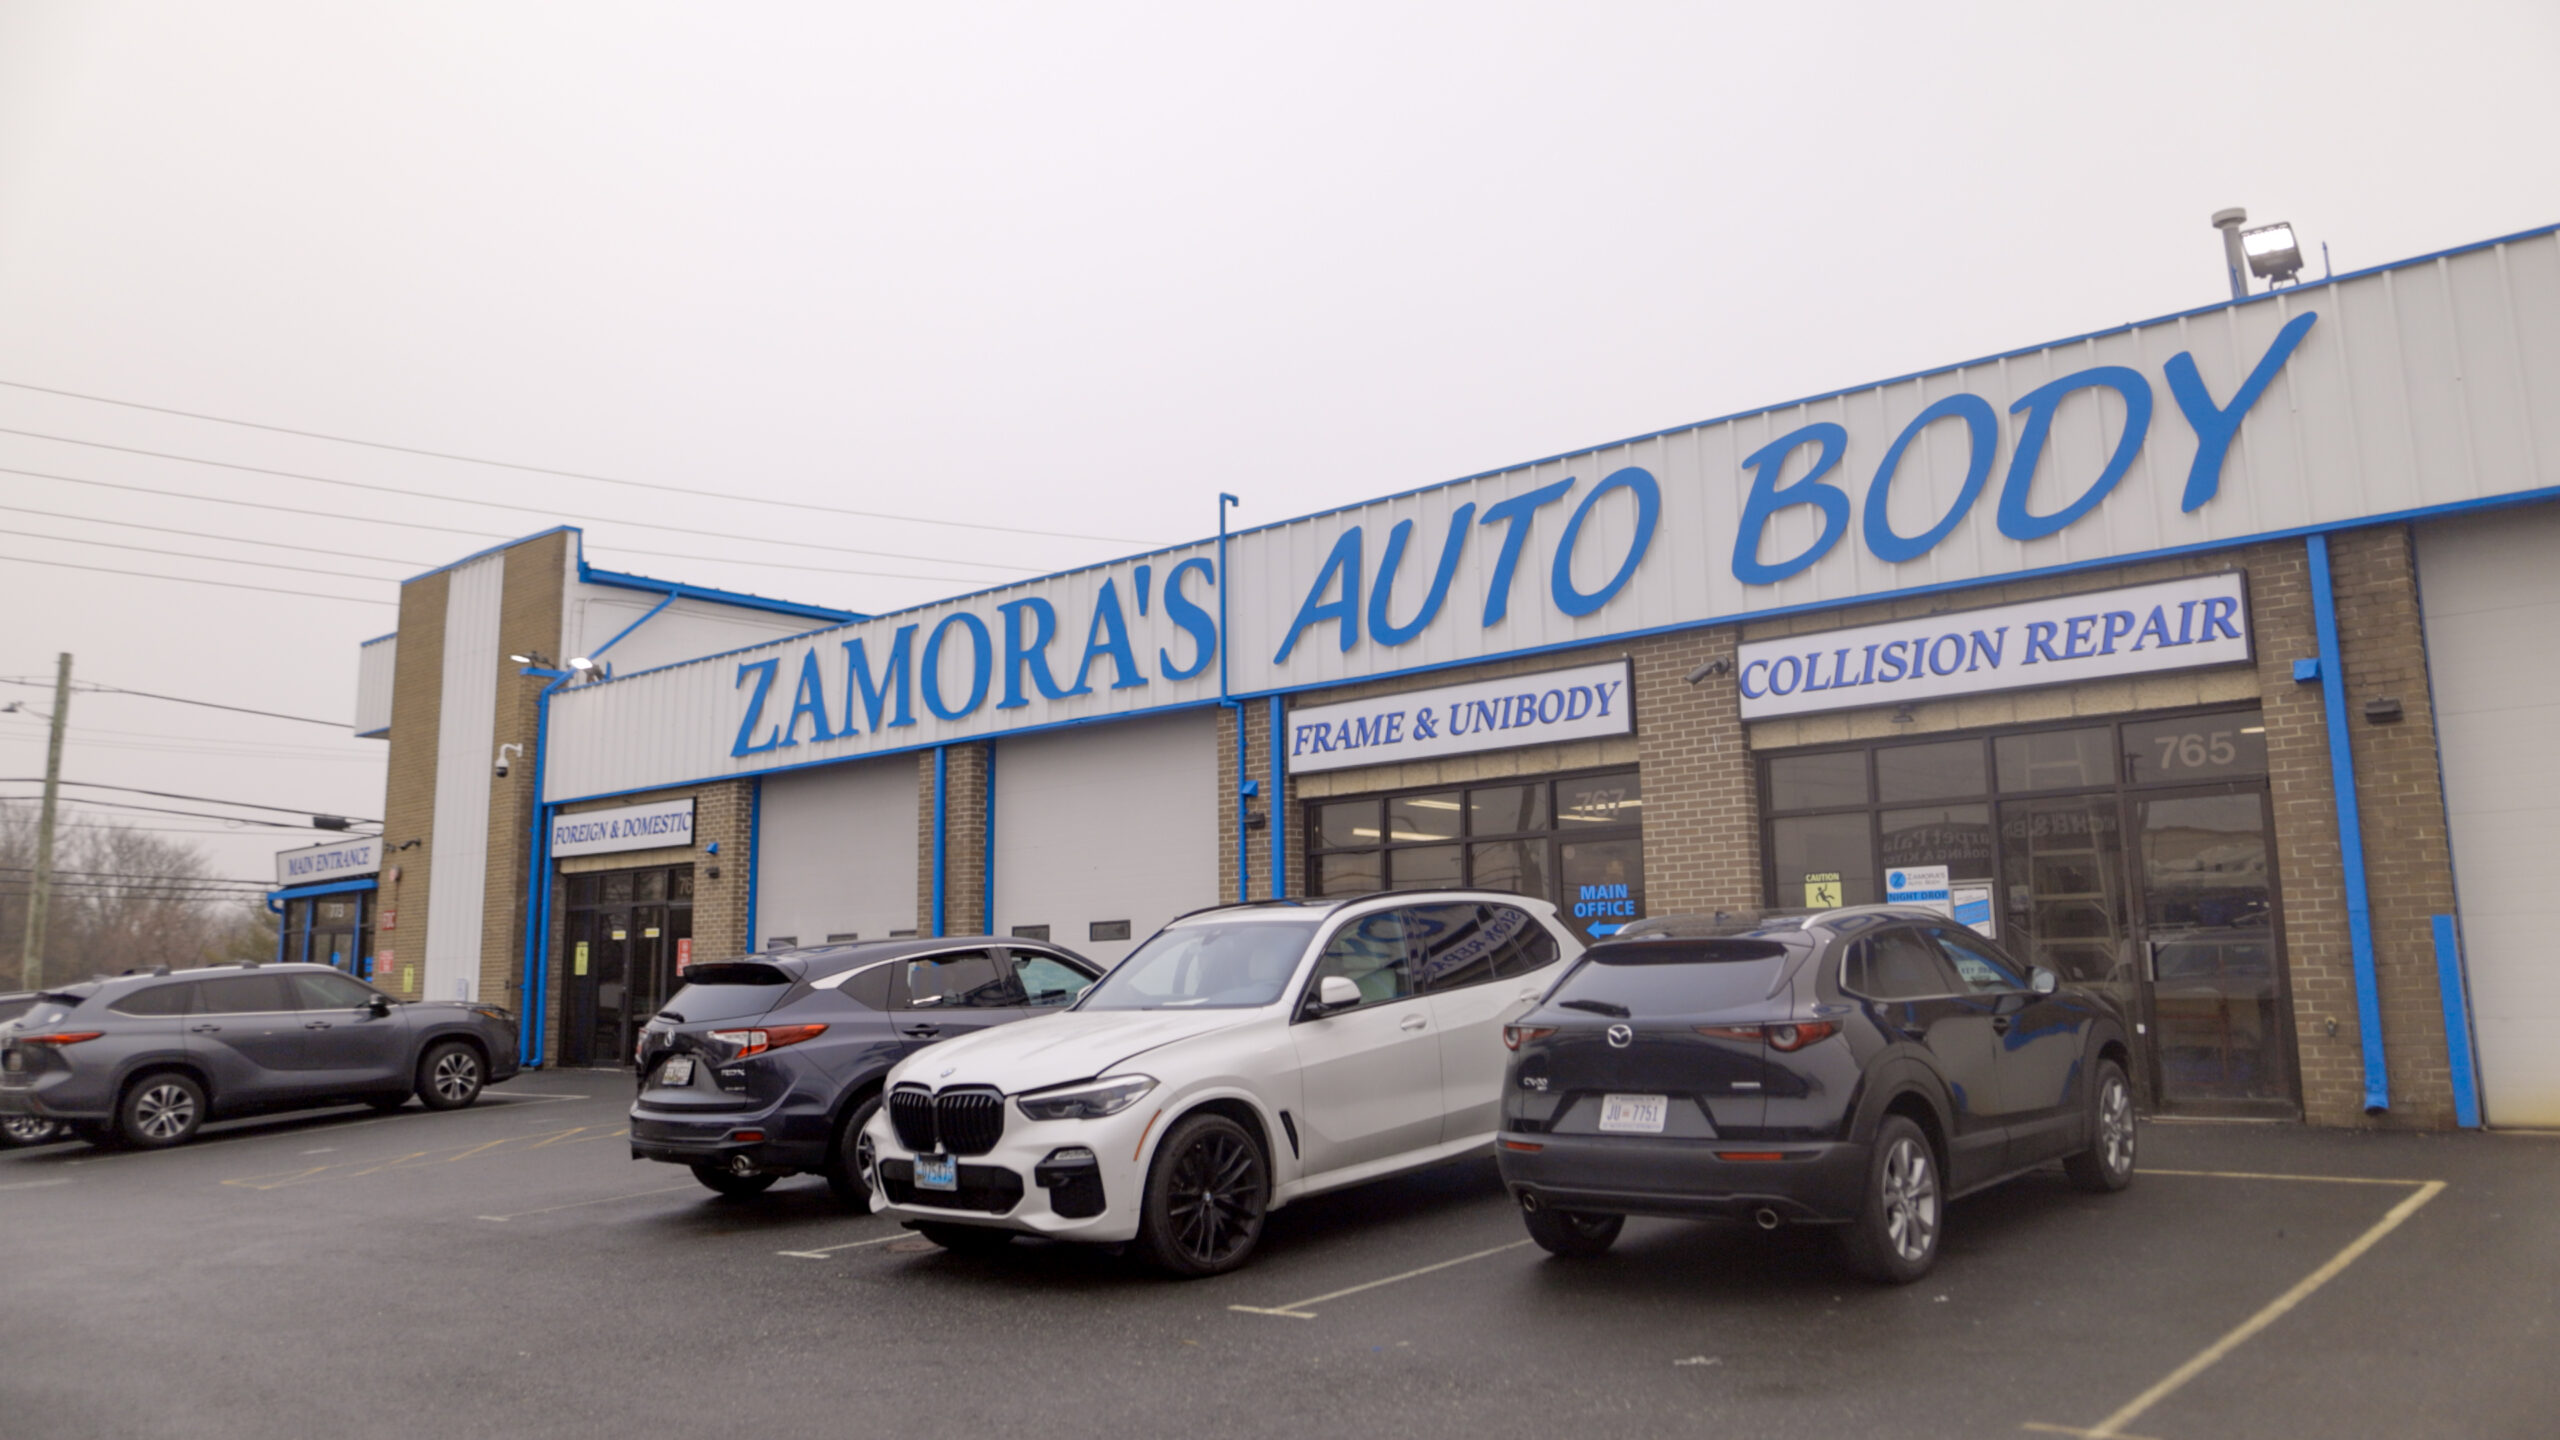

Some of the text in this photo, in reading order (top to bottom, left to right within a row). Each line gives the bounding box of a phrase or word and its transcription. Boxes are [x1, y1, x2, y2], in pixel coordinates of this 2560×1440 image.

[1273, 311, 2318, 665] AUTO BODY
[730, 557, 1218, 758] ZAMORA'S
[1739, 596, 2242, 699] COLLISION REPAIR
[1292, 680, 1623, 757] FRAME & UNIBODY
[2154, 731, 2237, 770] 765
[1575, 788, 1626, 818] 767
[554, 811, 693, 845] FOREIGN & DOMESTIC
[288, 846, 370, 876] MAIN ENTRANCE
[679, 877, 693, 895] 76
[1579, 884, 1629, 900] MAIN
[1805, 872, 1840, 883] CAUTION
[1573, 900, 1636, 918] OFFICE
[1888, 891, 1918, 902] NIGHT
[1920, 889, 1947, 900] DROP
[1606, 1103, 1659, 1122] JU 7751
